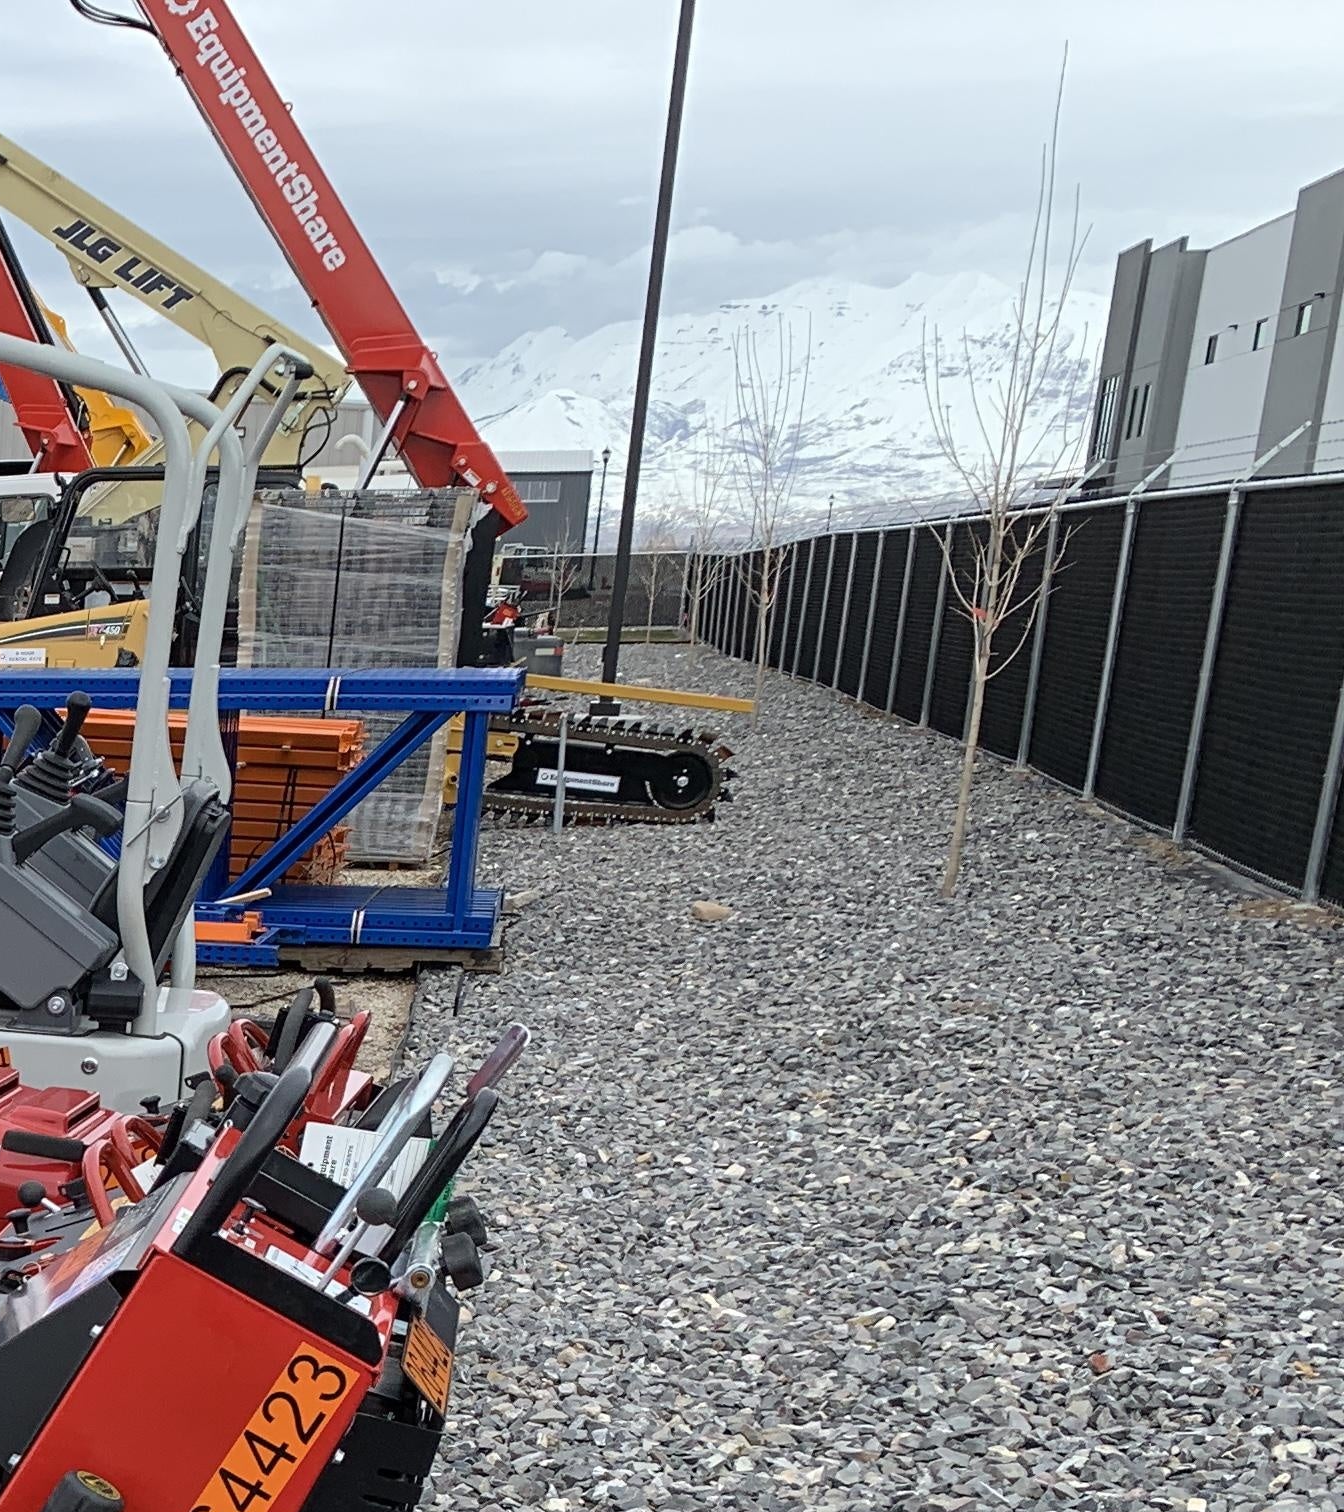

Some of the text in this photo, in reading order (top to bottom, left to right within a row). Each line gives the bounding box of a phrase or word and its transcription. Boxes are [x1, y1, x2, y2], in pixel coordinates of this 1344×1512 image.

[185, 7, 347, 273] EquipmentShare
[52, 219, 195, 311] JLG LIFT
